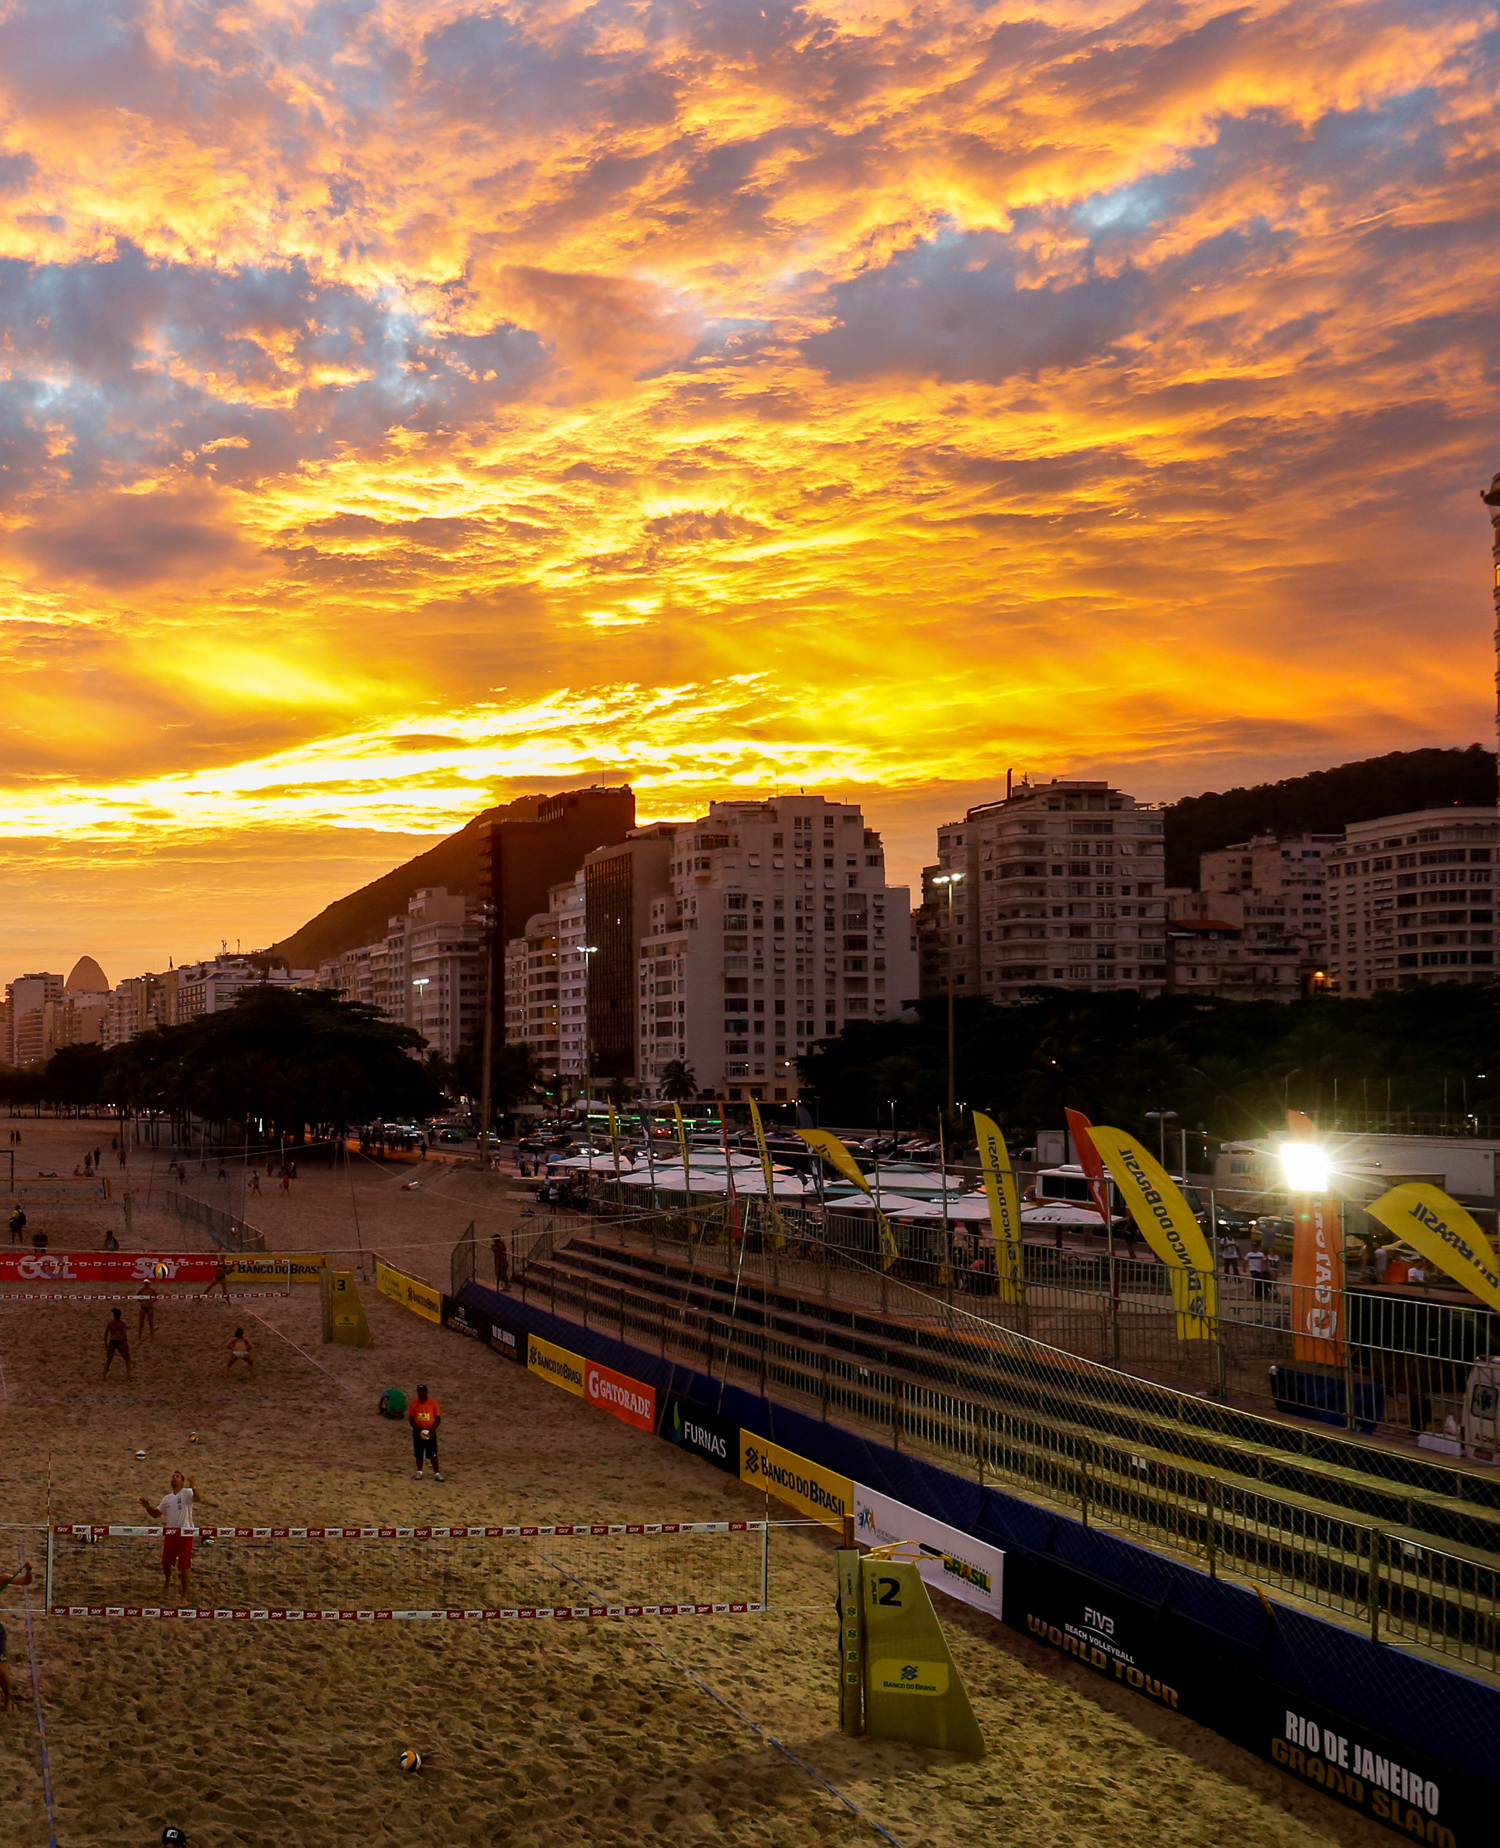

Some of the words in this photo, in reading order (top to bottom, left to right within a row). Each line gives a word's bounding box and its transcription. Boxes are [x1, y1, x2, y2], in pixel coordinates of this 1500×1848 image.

[18, 1255, 77, 1280] GOL
[238, 1264, 274, 1274] BANCO
[290, 1264, 320, 1274] BRAS
[337, 1280, 346, 1292] 3
[538, 1351, 556, 1373] BANCO
[564, 1363, 582, 1387] BRASIL
[588, 1370, 599, 1398] G
[600, 1379, 650, 1419] GATORADE
[684, 1420, 727, 1458] FURNAS
[761, 1456, 795, 1488] BANCO
[796, 1480, 809, 1499] DO
[810, 1480, 844, 1516] BRASIL
[878, 1578, 902, 1606] 2
[944, 1558, 991, 1594] BRASIL
[1084, 1606, 1114, 1636] FIVB
[1026, 1613, 1108, 1670] WORLD
[1112, 1657, 1179, 1709] TOUR
[1064, 1622, 1088, 1640] BEACH
[1088, 1634, 1135, 1664] VOLLEYBALL
[883, 1681, 906, 1689] BANCO
[915, 1684, 937, 1692] BRASIL
[1285, 1710, 1320, 1753] RIO
[1324, 1728, 1349, 1770] DE
[1352, 1744, 1440, 1816] JANEIRO
[1270, 1737, 1364, 1804] GRAND
[1371, 1788, 1458, 1848] SLAM
